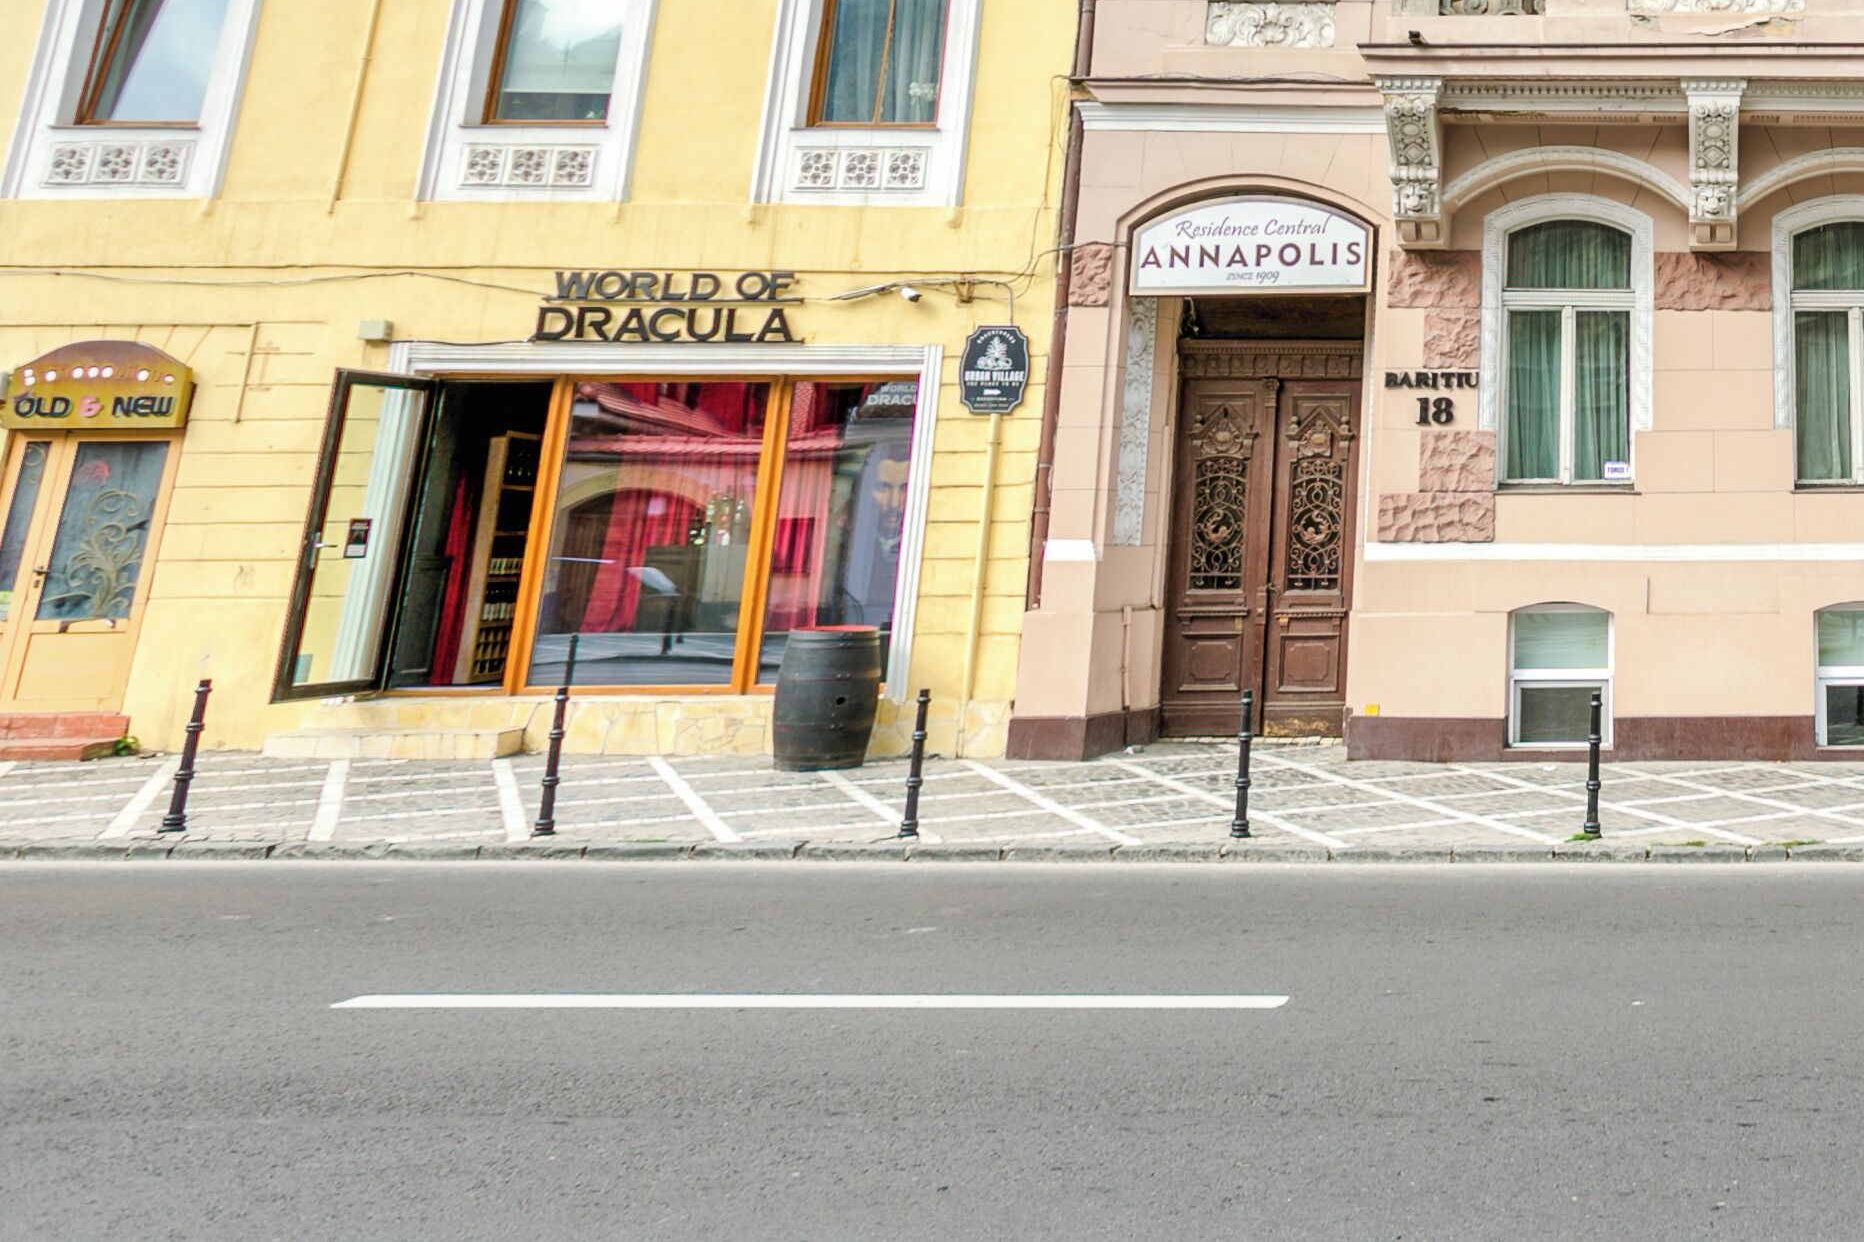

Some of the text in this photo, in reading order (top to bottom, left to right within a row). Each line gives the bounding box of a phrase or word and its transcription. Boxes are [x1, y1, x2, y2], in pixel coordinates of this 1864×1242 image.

[1175, 214, 1333, 240] Residence Central
[1139, 241, 1362, 269] ANNAPOLIS
[554, 270, 796, 301] WORLD OF
[1225, 270, 1280, 284] SINCE 1909
[535, 306, 794, 343] DRACULA
[992, 370, 1025, 382] VILLAGE
[14, 394, 175, 418] OLD & NEW
[1415, 396, 1454, 426] 18
